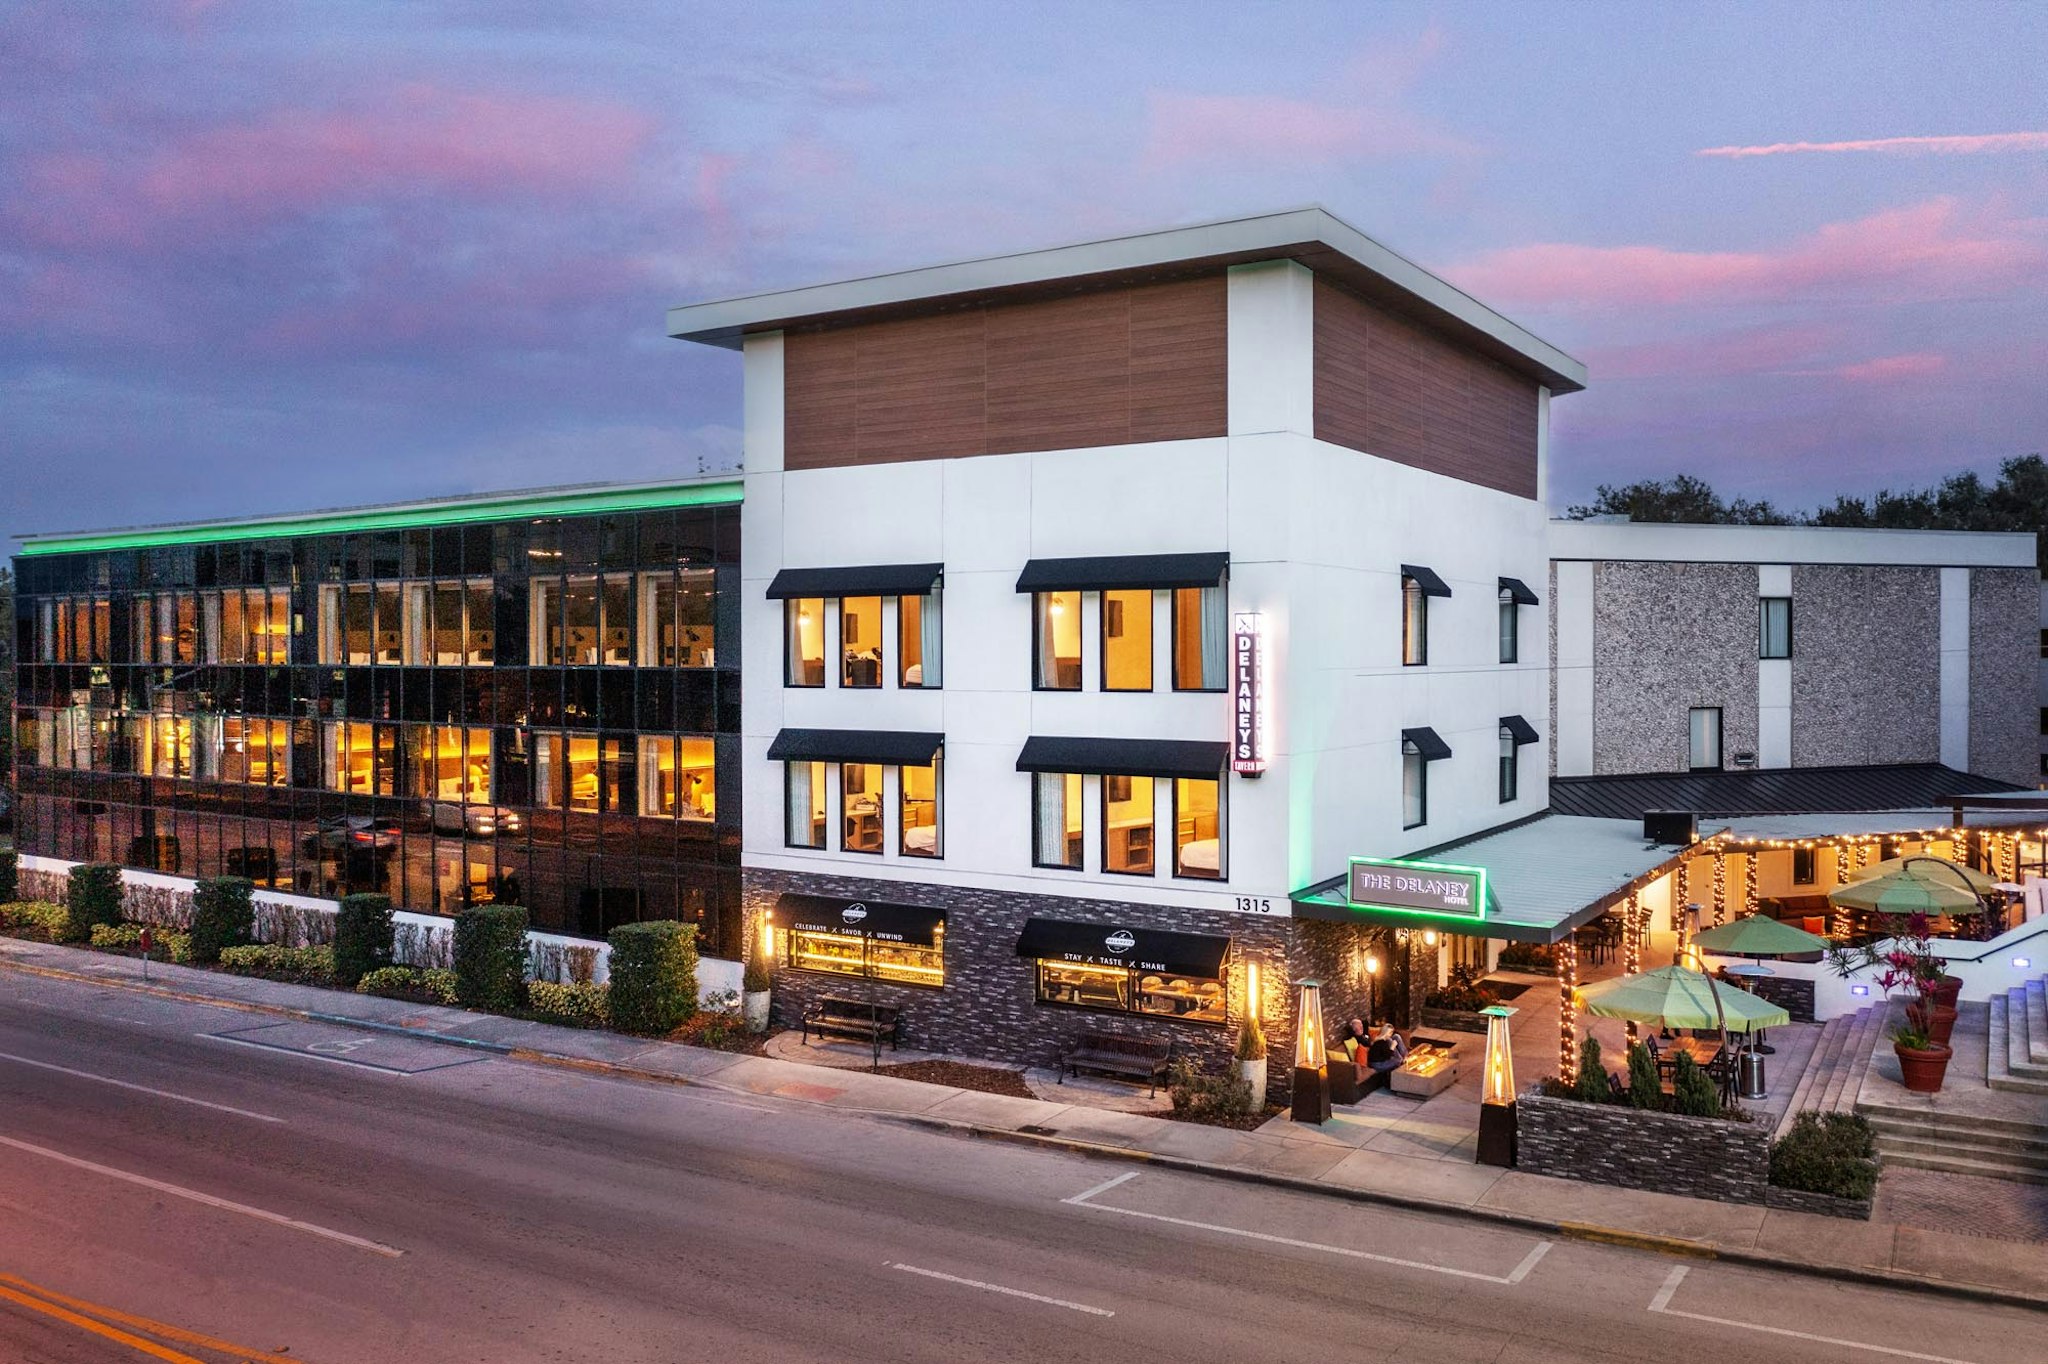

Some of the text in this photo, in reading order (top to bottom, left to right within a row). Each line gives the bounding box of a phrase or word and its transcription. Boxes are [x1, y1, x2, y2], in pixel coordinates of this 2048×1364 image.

[1238, 637, 1251, 759] DELANEYS
[1360, 872, 1469, 898] THE DELANEY
[1236, 897, 1270, 913] 1315
[1444, 896, 1469, 906] HOTEL
[795, 923, 903, 941] CELEBRATE SAVOR UNWIND
[1064, 952, 1166, 971] STAY TASTE SHARE
